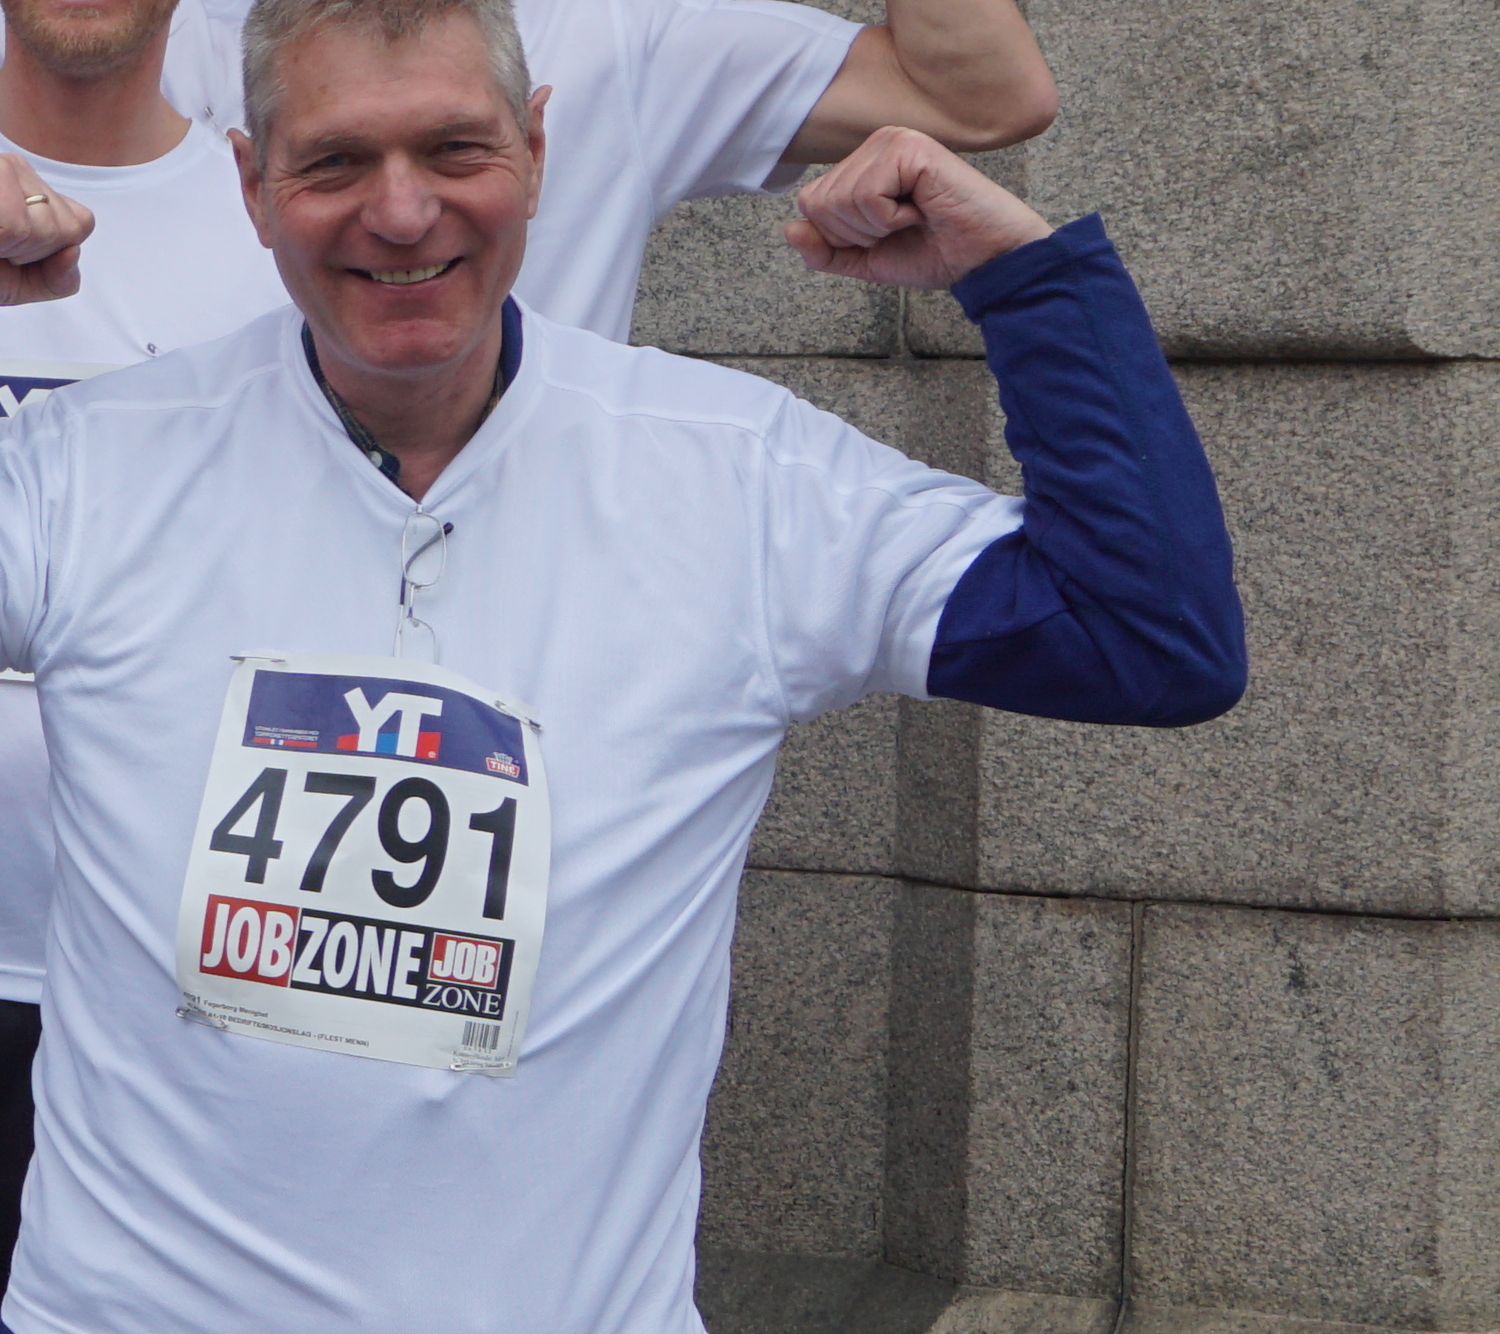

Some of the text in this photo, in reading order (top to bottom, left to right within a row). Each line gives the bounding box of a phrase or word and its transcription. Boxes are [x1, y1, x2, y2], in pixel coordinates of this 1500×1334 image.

[344, 687, 443, 757] YT
[209, 768, 517, 921] 4791
[434, 940, 498, 983] JOB
[423, 984, 502, 1014] ZONE
